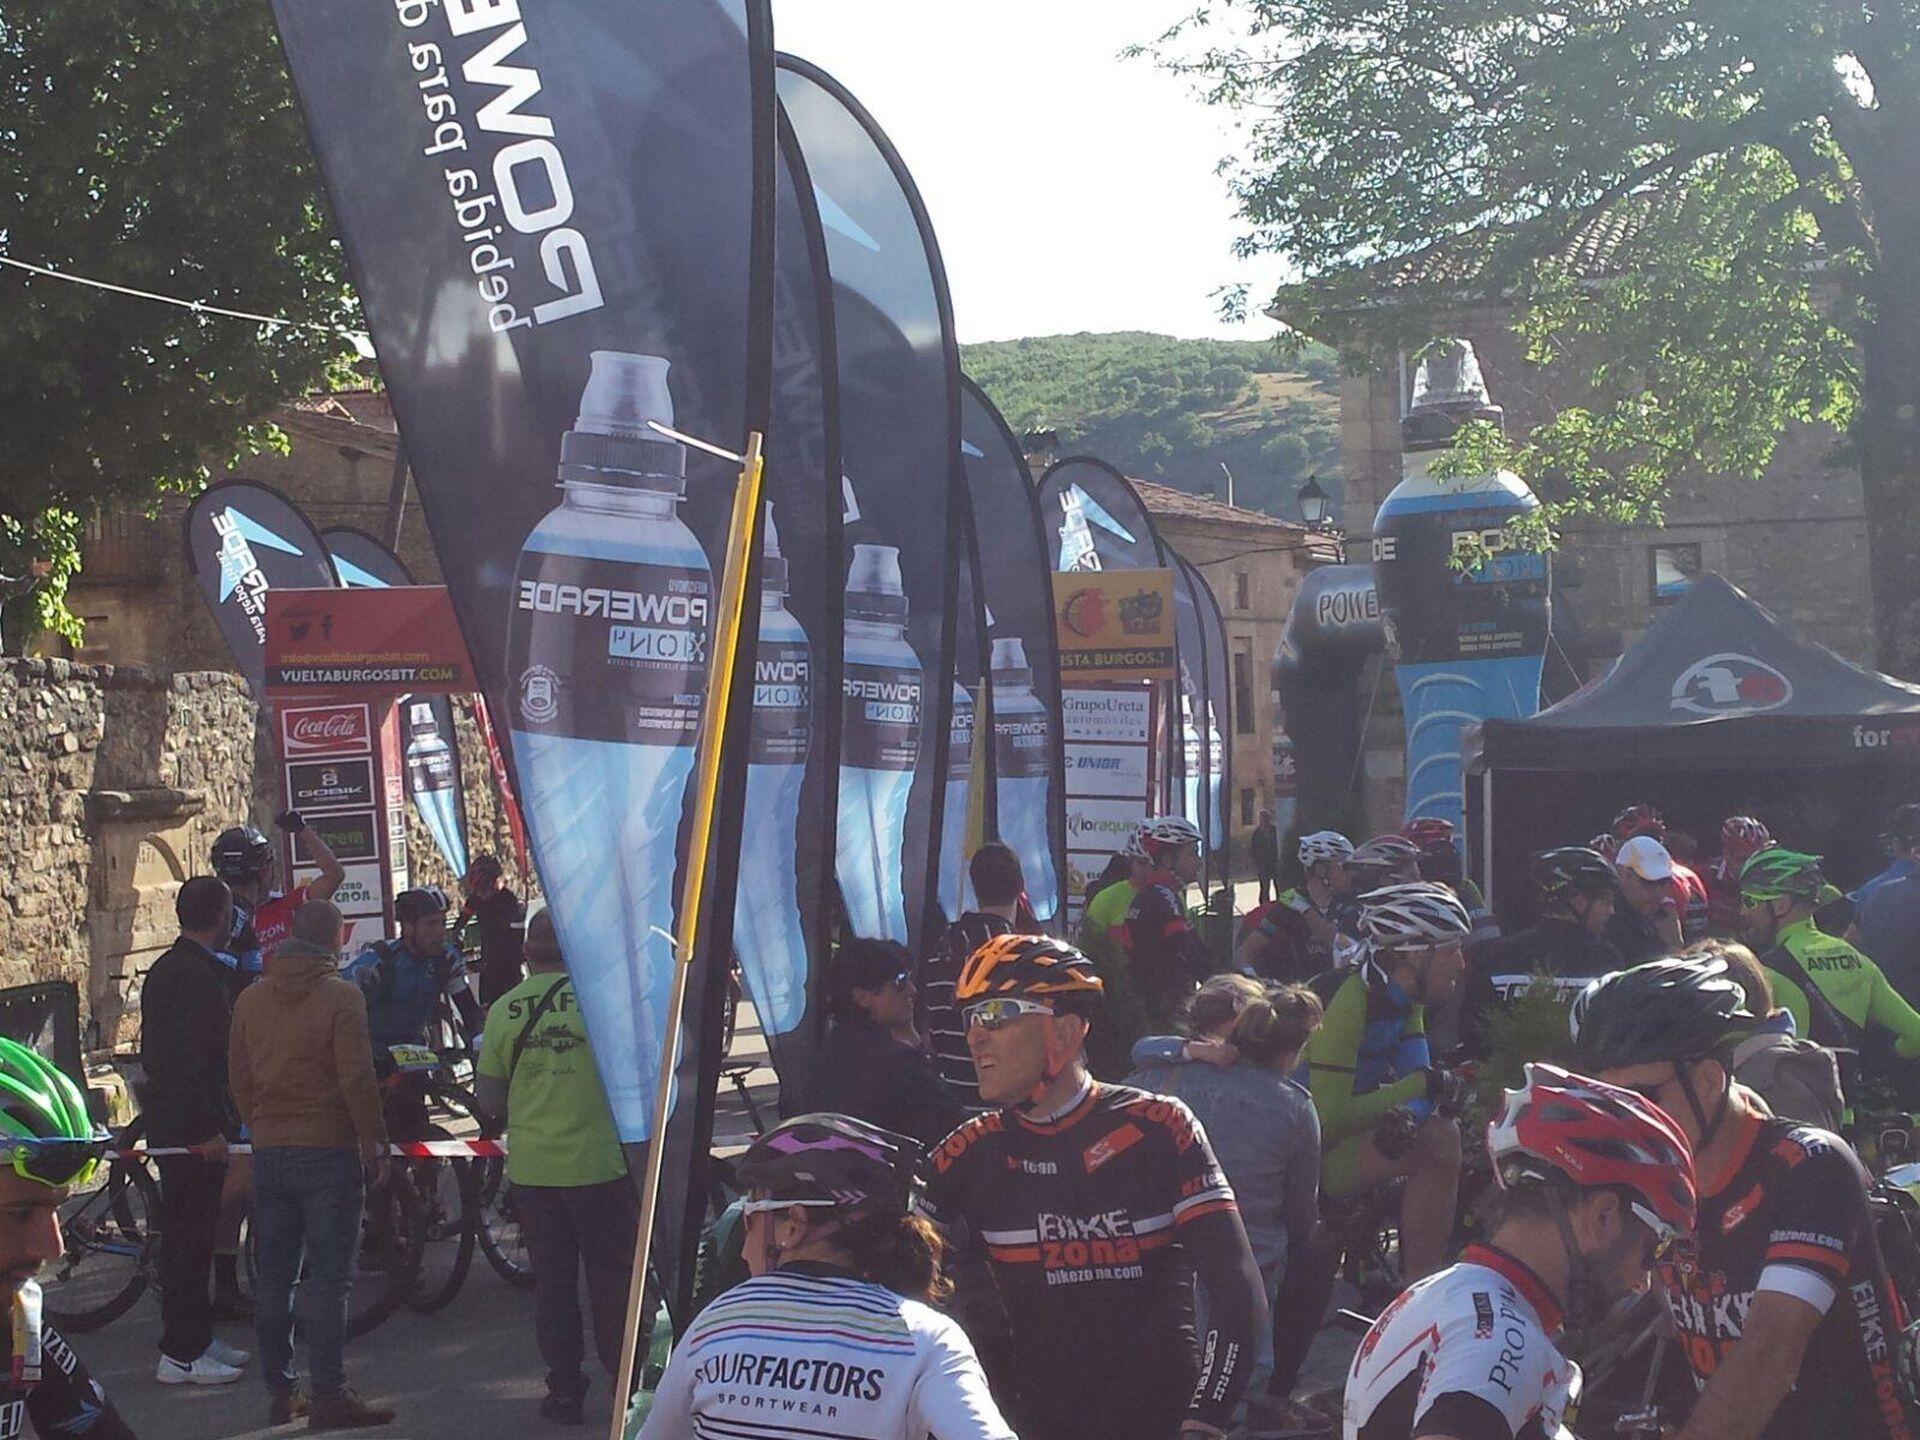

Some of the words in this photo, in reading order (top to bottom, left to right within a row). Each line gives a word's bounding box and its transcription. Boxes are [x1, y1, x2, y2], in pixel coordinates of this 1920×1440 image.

[281, 669, 453, 683] VUELTABURGOSBTT.COM
[298, 786, 363, 798] GOBIK
[1807, 954, 1862, 973] ANTON
[508, 992, 580, 1019] STF
[1038, 1208, 1134, 1242] BIKE
[718, 1393, 838, 1418] SPORTWEAR
